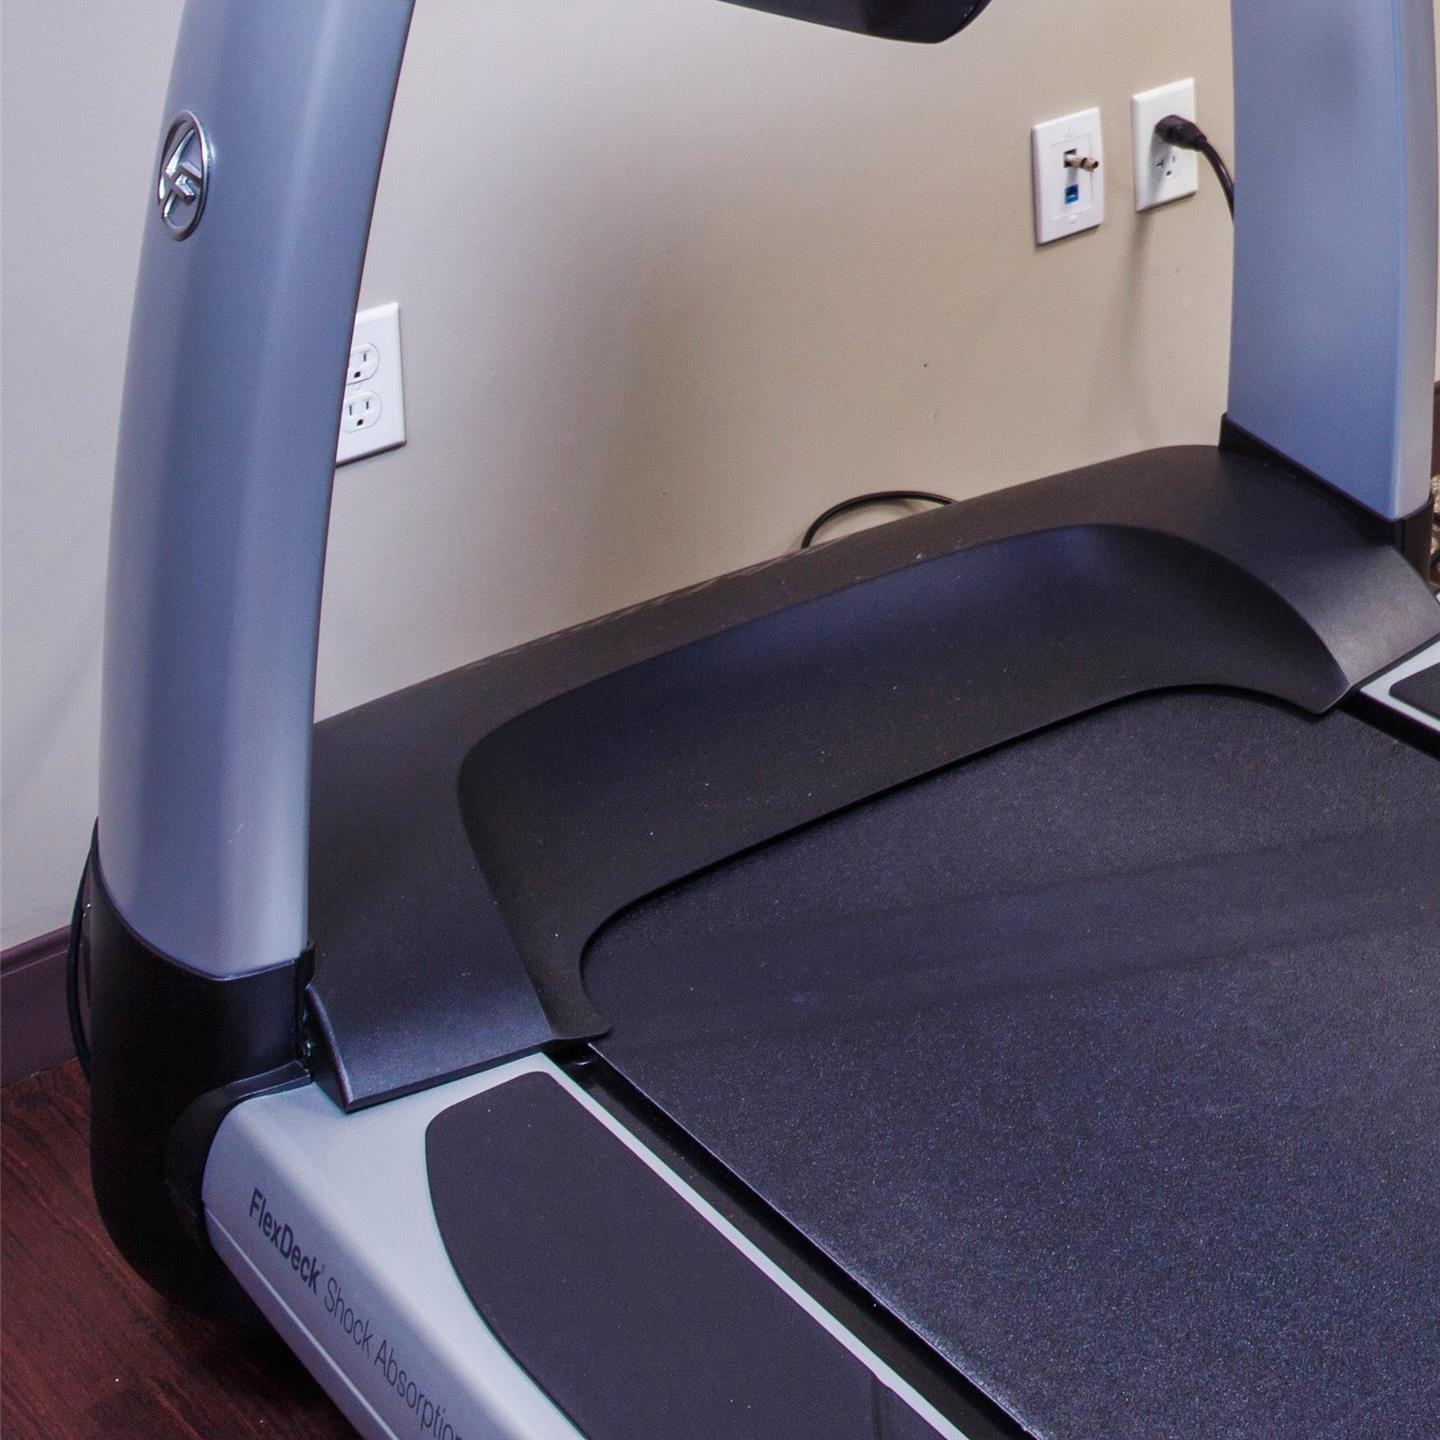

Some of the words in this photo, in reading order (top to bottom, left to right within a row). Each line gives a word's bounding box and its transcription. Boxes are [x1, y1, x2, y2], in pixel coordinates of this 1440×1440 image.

[249, 1187, 320, 1294] FlexDeck
[324, 1277, 373, 1357] Shock
[374, 1339, 463, 1440] Absorptio
